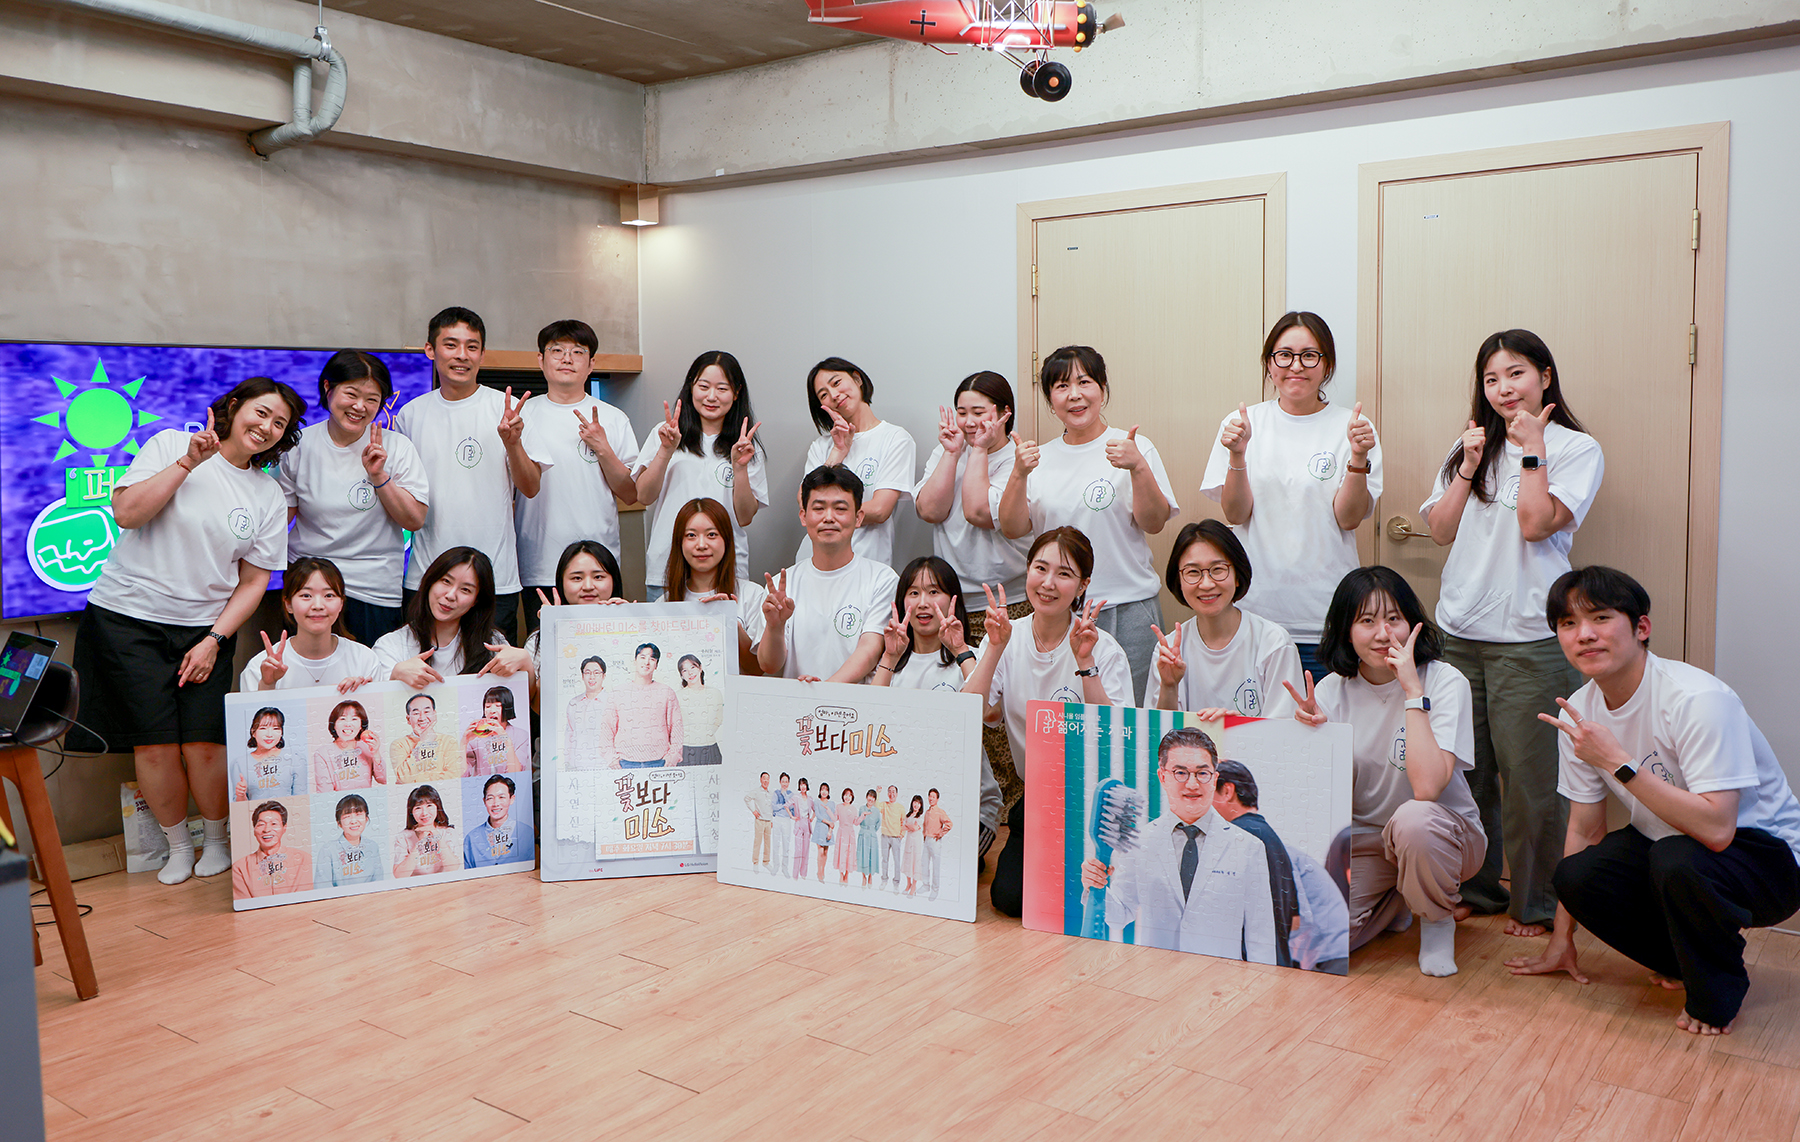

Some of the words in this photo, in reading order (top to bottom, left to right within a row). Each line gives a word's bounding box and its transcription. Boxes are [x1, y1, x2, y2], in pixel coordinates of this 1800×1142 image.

[795, 713, 848, 756] 꽃보다
[849, 723, 898, 758] 미소
[614, 772, 671, 813] 꽃보다
[624, 807, 676, 840] 미소
